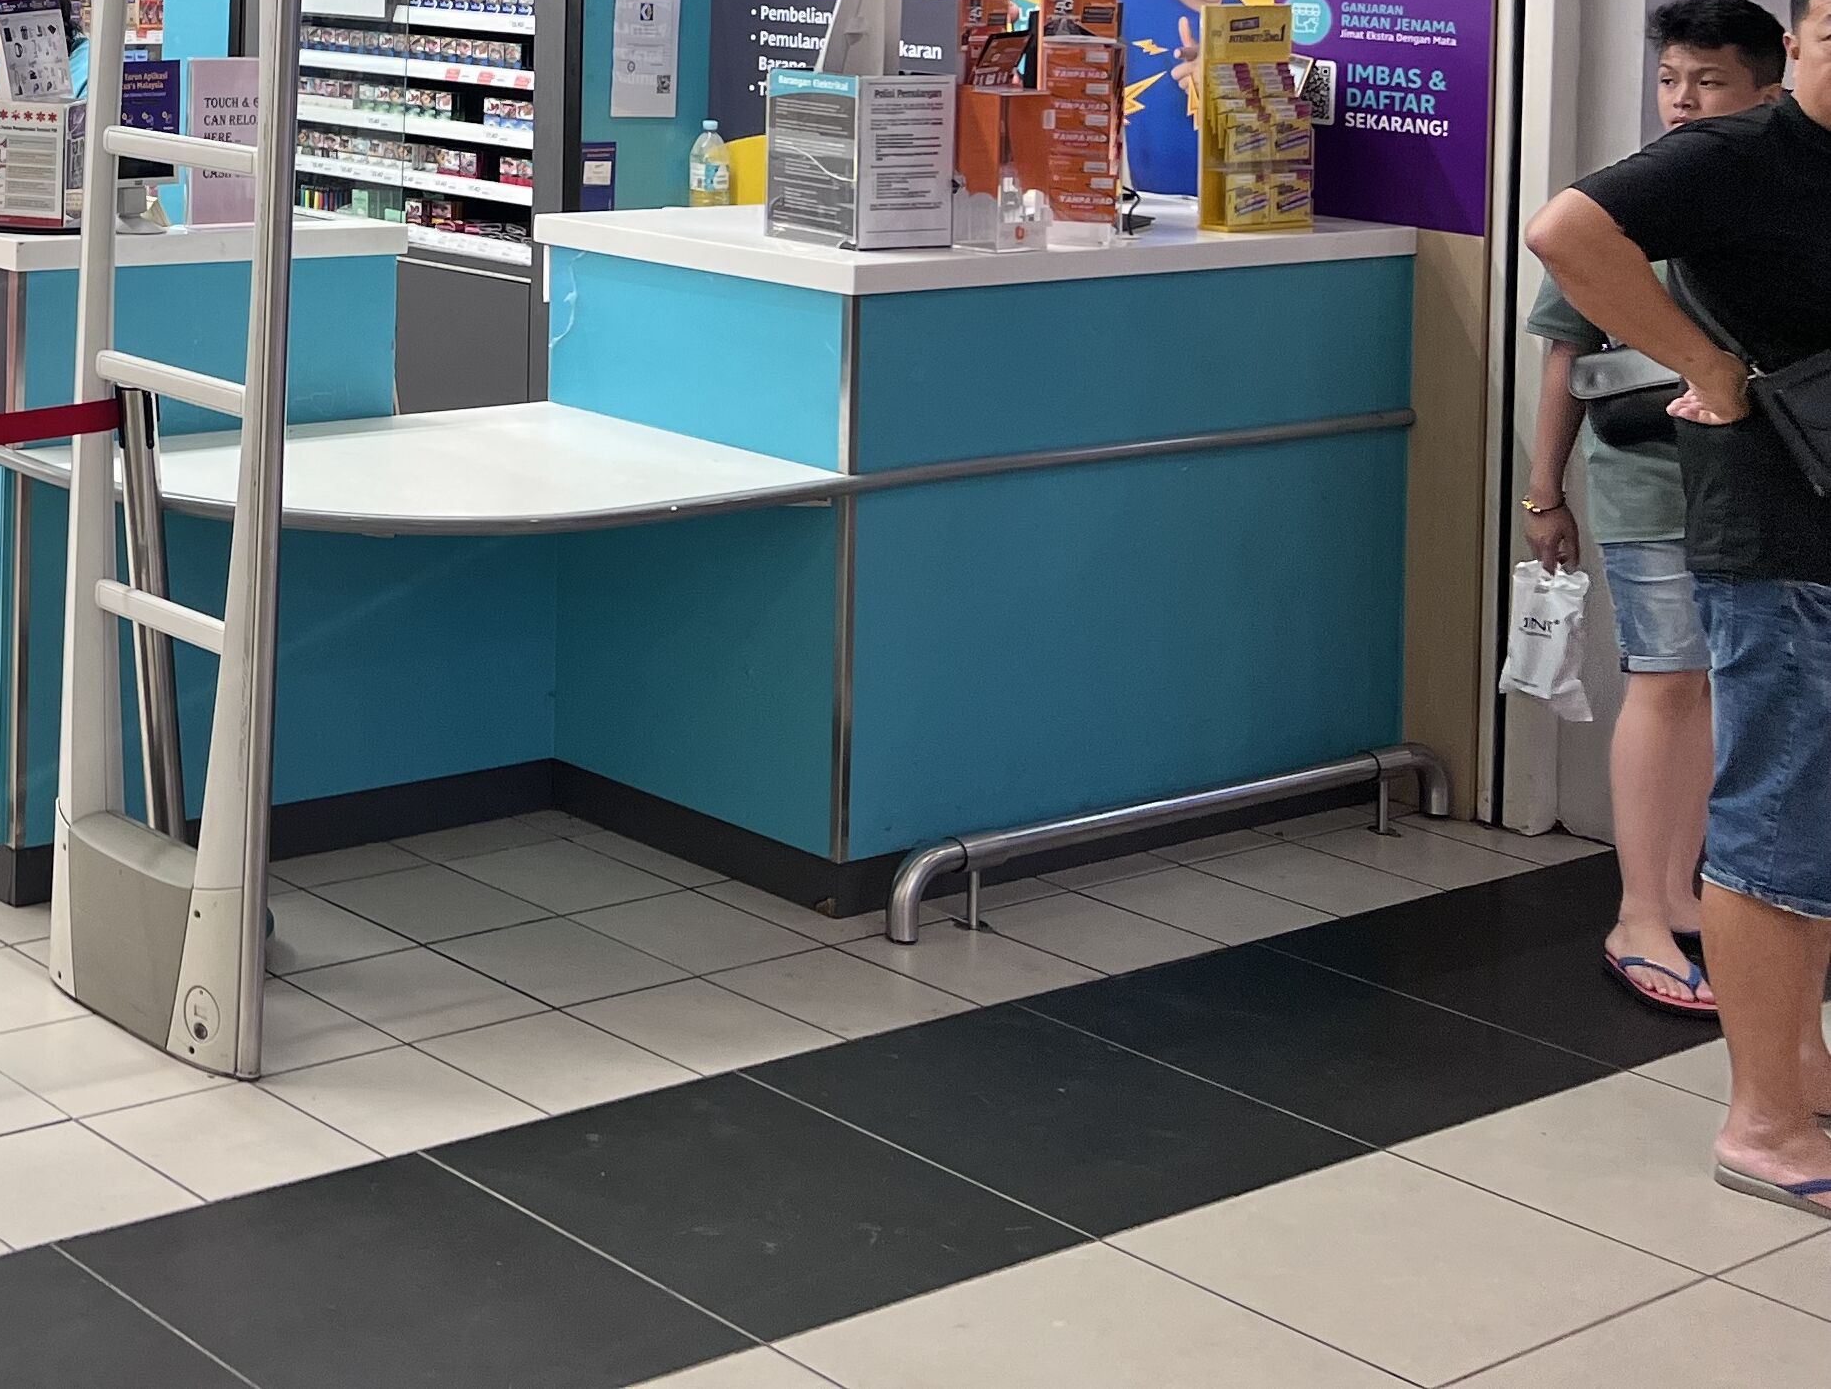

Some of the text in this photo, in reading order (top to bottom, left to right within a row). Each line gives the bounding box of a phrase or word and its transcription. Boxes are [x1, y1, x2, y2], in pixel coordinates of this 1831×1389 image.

[760, 5, 834, 25] Pembelian
[1341, 2, 1404, 15] GANJARAN
[1341, 15, 1456, 35] RAKAN JENAMA
[759, 31, 827, 51] Pemulang
[1340, 30, 1457, 46] Jimat Ekstra Dengan Mata
[1347, 63, 1447, 92] IMBAS &
[203, 97, 250, 109] TOUCH &
[1345, 87, 1436, 115] DAFTAR
[203, 114, 259, 126] CAN RELO
[1344, 112, 1450, 137] SEKARANG!
[203, 132, 233, 143] HERE
